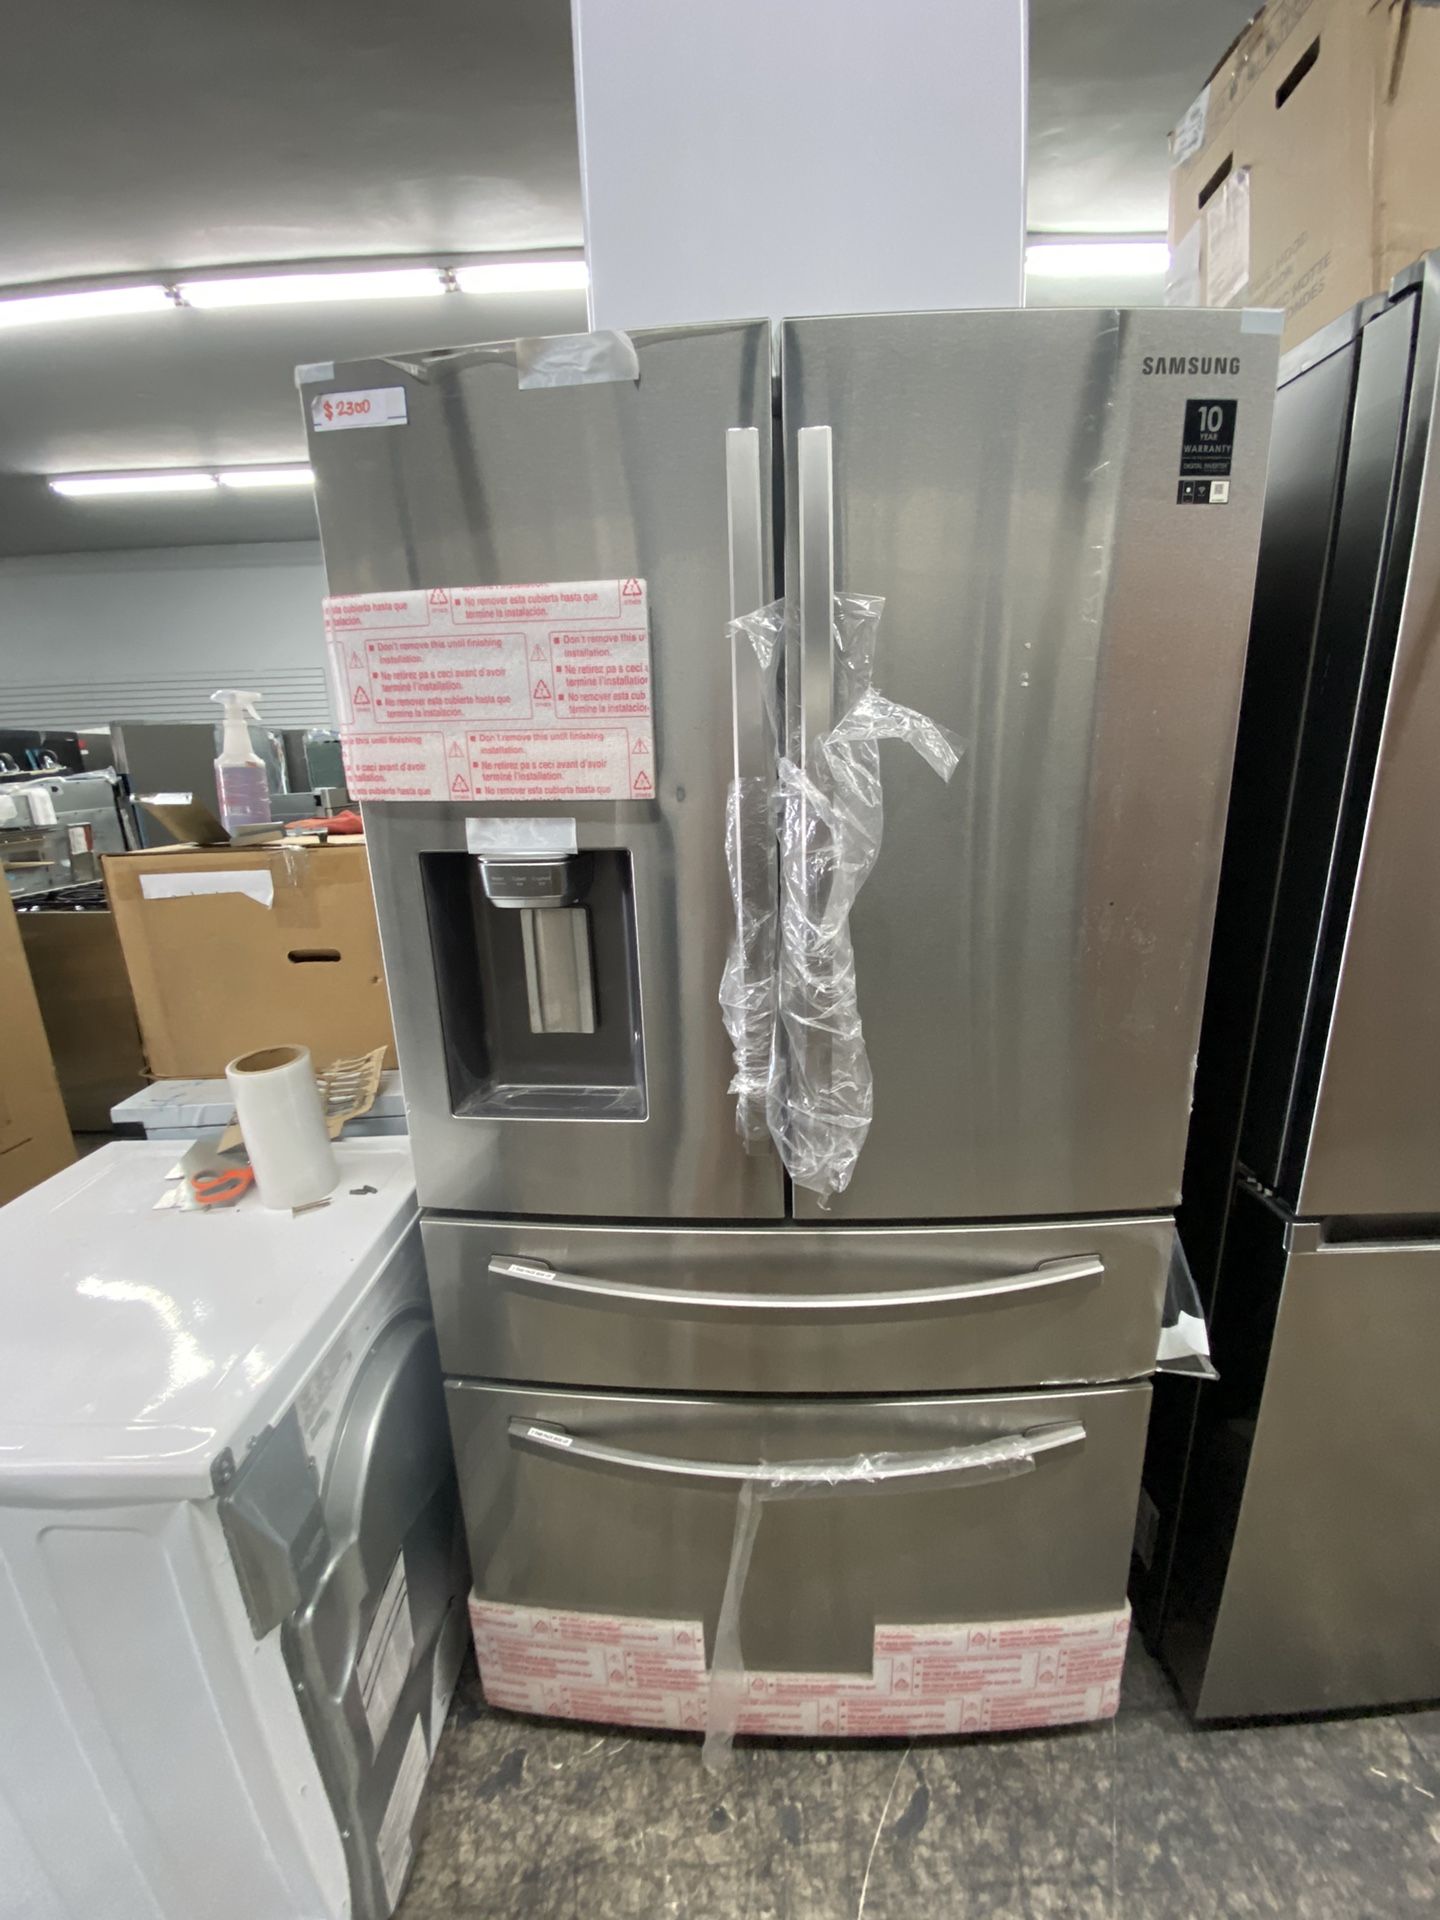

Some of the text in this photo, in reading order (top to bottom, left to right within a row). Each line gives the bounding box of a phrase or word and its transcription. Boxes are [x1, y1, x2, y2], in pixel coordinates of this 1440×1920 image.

[1142, 357, 1241, 375] SAMSUNG
[1198, 405, 1223, 432] 10
[1200, 433, 1218, 441] YEAR
[1184, 444, 1232, 453] WARRANTY
[587, 634, 618, 643] remove
[620, 634, 637, 642] this
[626, 664, 643, 673] ceci
[613, 692, 630, 700] esta
[502, 733, 531, 742] remove
[533, 732, 549, 741] this
